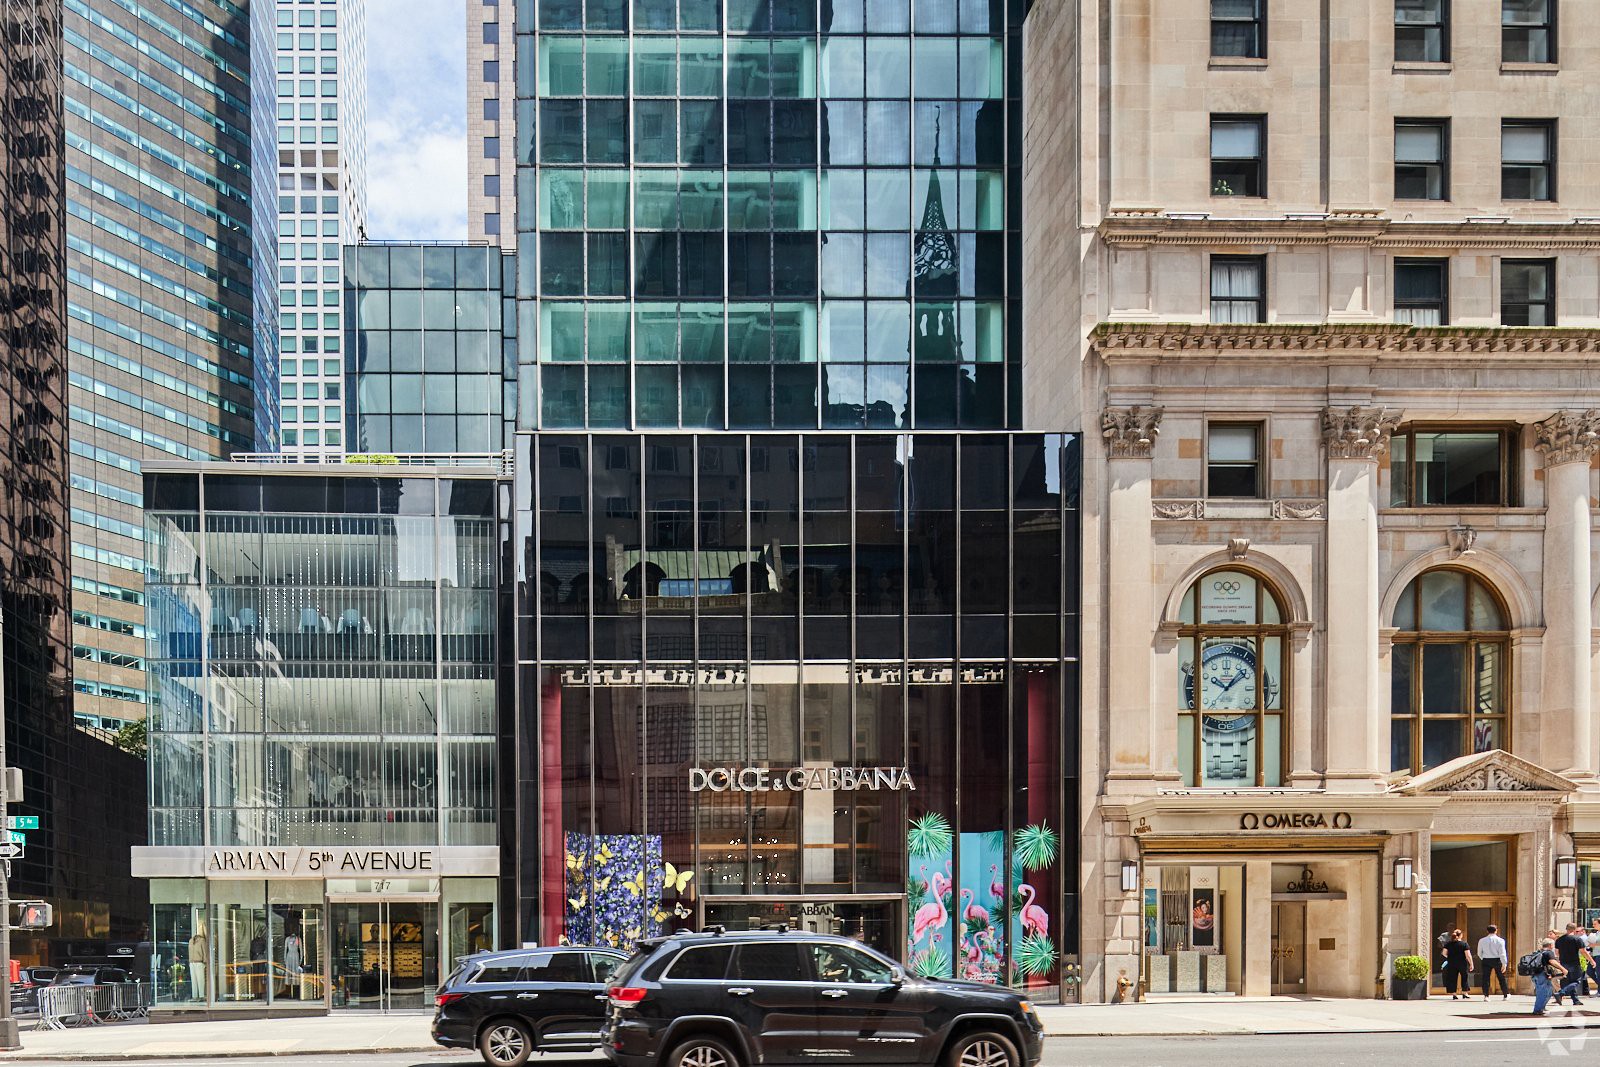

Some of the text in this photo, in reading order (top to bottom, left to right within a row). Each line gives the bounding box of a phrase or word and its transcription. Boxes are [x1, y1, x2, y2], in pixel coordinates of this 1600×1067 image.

[688, 767, 916, 791] DOLCE & GABBANA
[19, 817, 25, 828] 5
[1263, 814, 1328, 828] OMEGA
[208, 851, 288, 871] ARMANI
[308, 851, 334, 871] 5th
[340, 851, 433, 870] AVENUE
[374, 881, 392, 891] 717
[1286, 881, 1329, 892] OMEGA
[1390, 900, 1404, 909] 711
